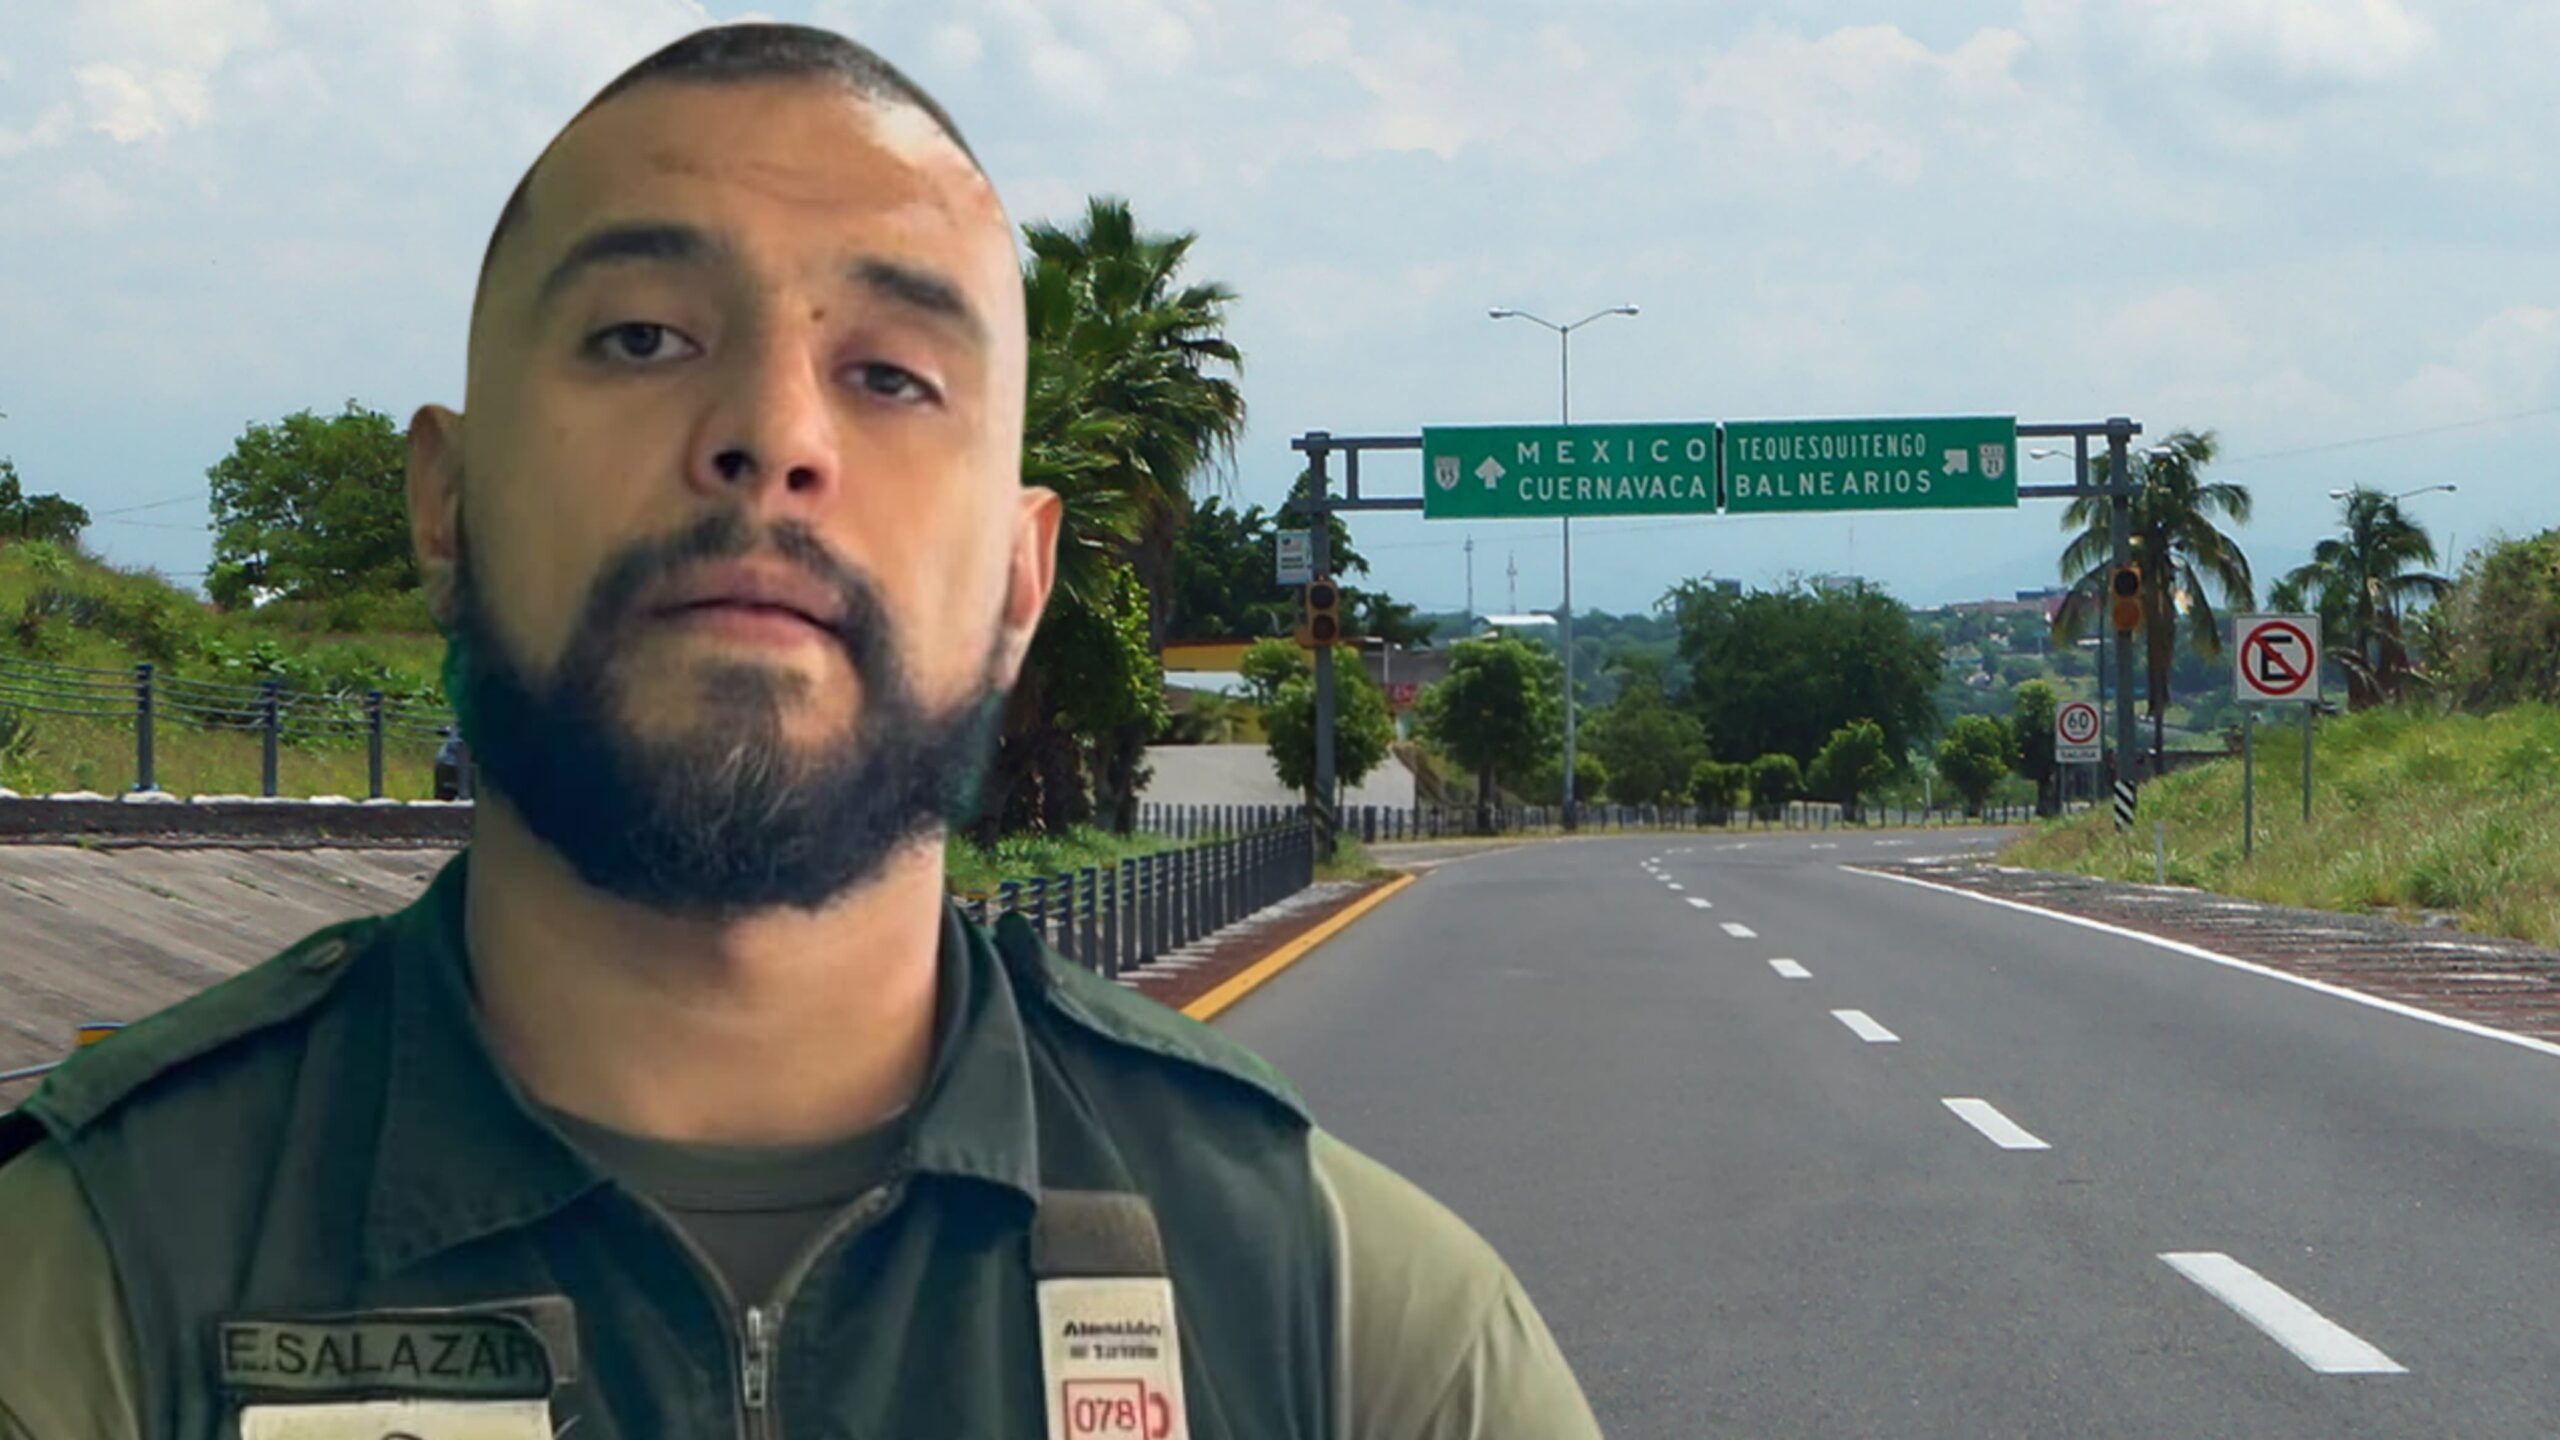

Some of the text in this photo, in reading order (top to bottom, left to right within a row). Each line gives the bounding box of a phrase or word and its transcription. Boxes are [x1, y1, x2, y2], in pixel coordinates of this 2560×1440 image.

[1517, 438, 1707, 464] MEXICO
[1738, 433, 1927, 461] TEQUESQUITENGO
[1518, 475, 1707, 500] CUERNAVACA
[1735, 469, 1931, 497] BALNEARIOS
[2067, 711, 2089, 730] 60
[1075, 1397, 1137, 1433] 078
